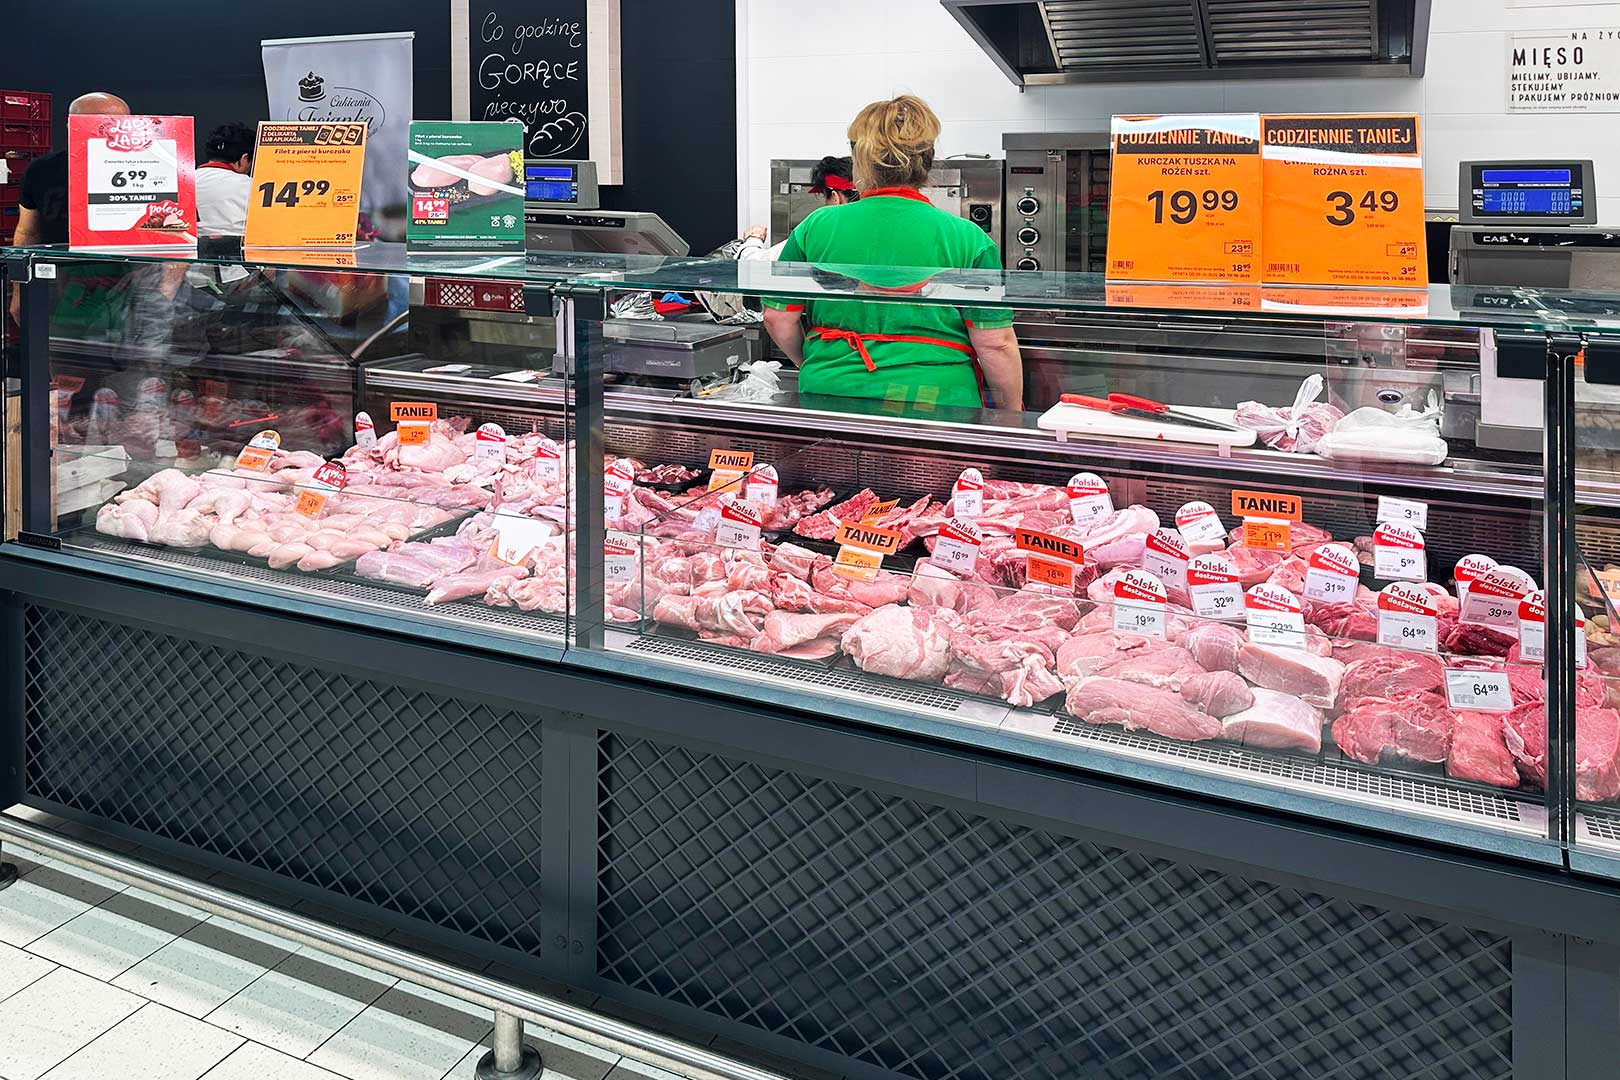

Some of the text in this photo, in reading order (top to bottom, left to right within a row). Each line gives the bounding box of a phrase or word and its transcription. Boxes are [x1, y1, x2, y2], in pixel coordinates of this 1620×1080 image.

[481, 11, 582, 55] Co godzinę
[1571, 32, 1588, 40] NA
[1512, 46, 1584, 69] MIĘSO
[479, 53, 579, 89] GORĄCE
[1511, 83, 1564, 92] STEKUJEMY
[330, 95, 371, 108] Cukiernia
[1519, 93, 1566, 102] PAKUJEMY
[1267, 128, 1411, 144] CODZIENNIE TANIEJ
[1162, 166, 1192, 176] ROŻEN
[1313, 166, 1368, 176] ROŻNA szt.
[149, 202, 184, 217] poleca
[395, 407, 433, 417] TANIEJ
[715, 455, 750, 467] TANIEJ
[1073, 478, 1099, 487] Polski
[731, 501, 757, 518] Polski
[868, 504, 895, 516] TANIEJ
[1180, 506, 1206, 515] Polski
[1238, 496, 1296, 515] TANIEJ
[950, 518, 978, 537] Polski
[1383, 524, 1415, 541] Polski
[844, 526, 895, 548] TANIEJ
[1155, 529, 1184, 551] Polski
[1381, 534, 1414, 548] dostawca
[1022, 534, 1079, 558] TANIEJ
[1152, 538, 1181, 558] dostawca
[1322, 547, 1354, 567] Polski
[1194, 560, 1228, 573] Polski
[1318, 557, 1349, 575] dostawca
[1125, 574, 1159, 593] Polski
[1194, 571, 1228, 582] dostawca
[1484, 574, 1522, 591] Polski
[1122, 585, 1156, 602] dostawca
[1255, 586, 1291, 604] Polski
[1390, 584, 1429, 606] Polski
[1480, 582, 1515, 598] dostawca
[1254, 597, 1290, 612] dostawca
[1387, 596, 1425, 615] dostawca
